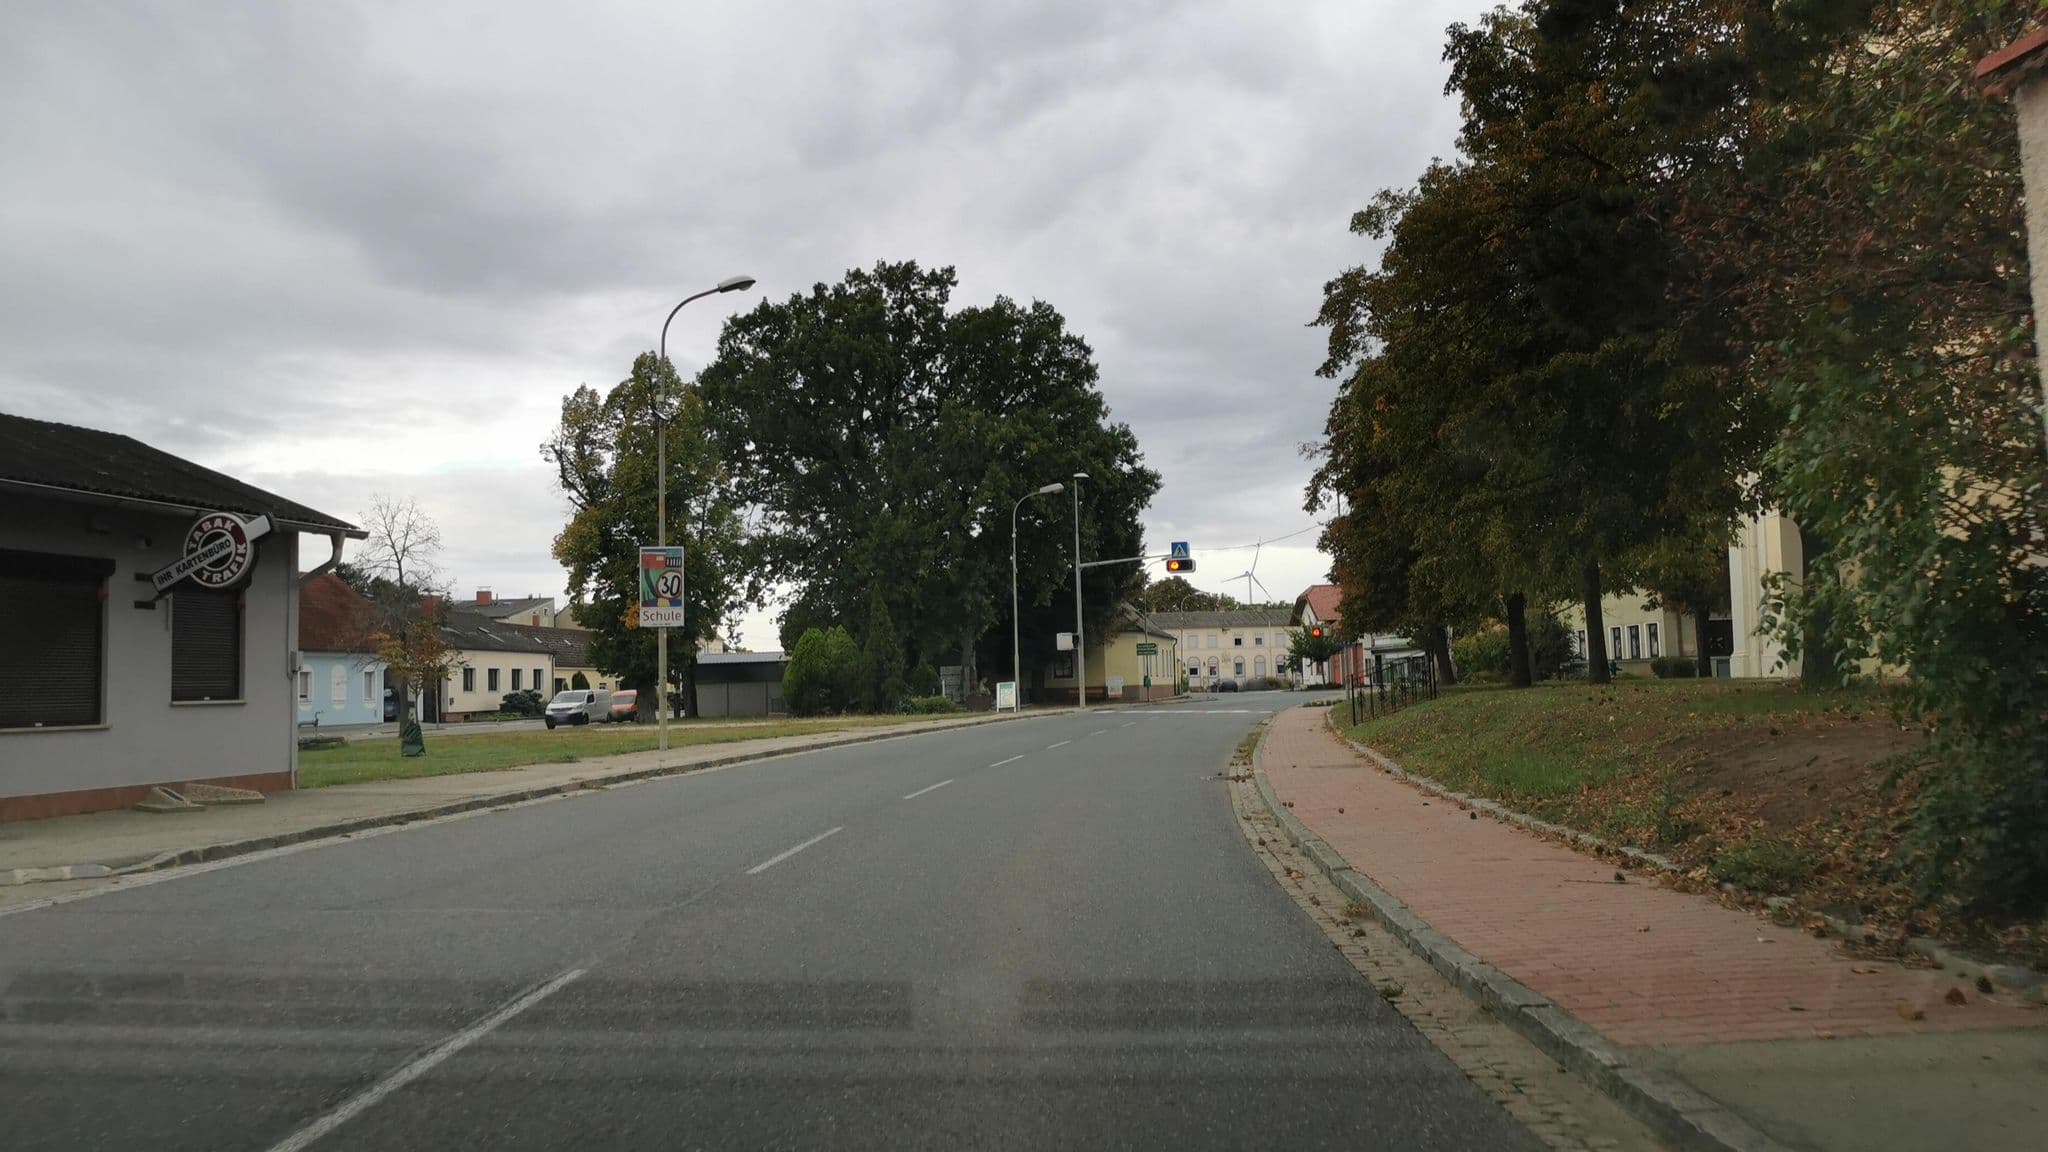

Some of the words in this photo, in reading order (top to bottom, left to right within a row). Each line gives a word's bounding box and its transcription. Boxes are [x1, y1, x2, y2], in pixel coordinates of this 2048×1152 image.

[188, 518, 235, 550] TABAK
[156, 571, 174, 585] IHR
[175, 539, 232, 574] KARTENBÜRO
[202, 543, 247, 583] TRAFIK
[661, 575, 681, 596] 30
[643, 611, 682, 621] Schule
